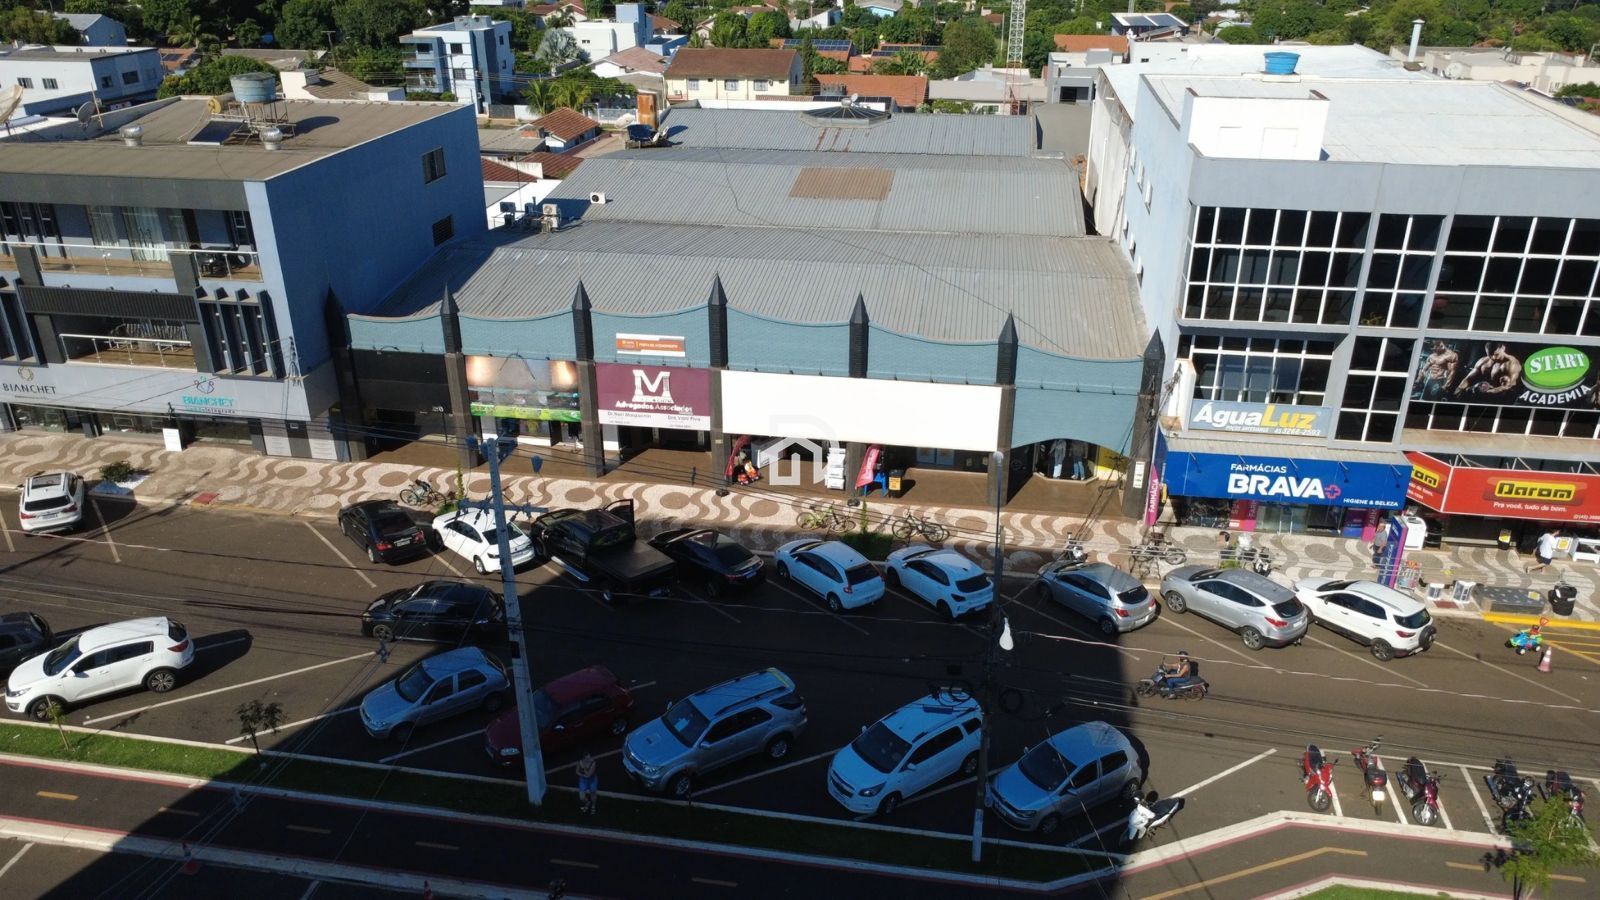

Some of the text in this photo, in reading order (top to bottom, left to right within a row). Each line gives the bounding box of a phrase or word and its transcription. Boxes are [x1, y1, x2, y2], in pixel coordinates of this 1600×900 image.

[1530, 353, 1584, 373] START
[2, 383, 56, 395] BIANCHET
[1520, 384, 1591, 404] ACADEMIA
[183, 395, 235, 407] BIANCHET
[615, 400, 654, 411] Advogados
[655, 403, 693, 414] Associados
[1193, 402, 1318, 429] ÁguaLuz
[1230, 463, 1287, 474] FARMÁCIAS
[1227, 473, 1325, 499] BRAVA
[1497, 481, 1573, 498] Darom
[1148, 479, 1159, 513] FARMÁCIA
[1524, 503, 1540, 511] tudo
